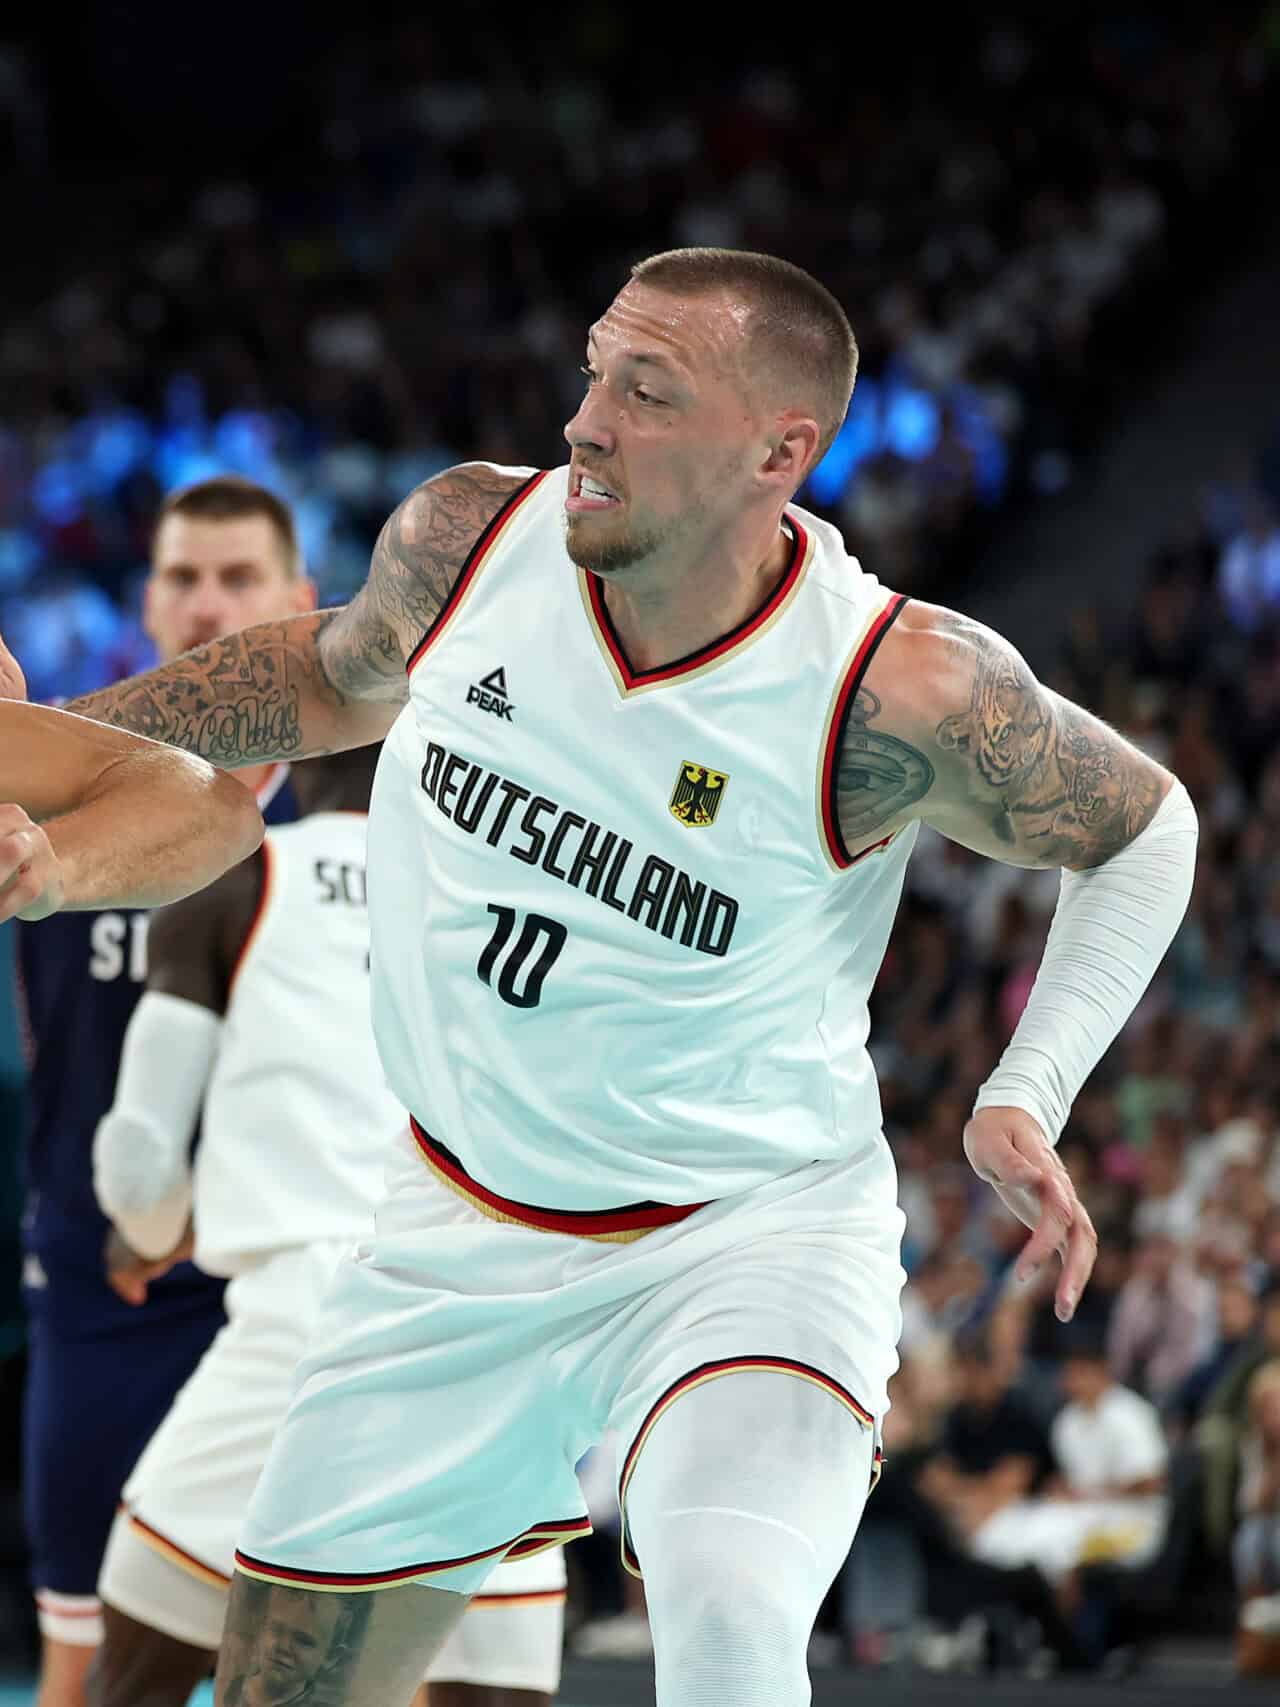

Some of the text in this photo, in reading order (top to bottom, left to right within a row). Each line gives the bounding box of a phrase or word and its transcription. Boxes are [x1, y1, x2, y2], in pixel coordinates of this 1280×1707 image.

[465, 684, 515, 722] PEAK
[420, 741, 739, 958] DEUTSCHLAND
[476, 902, 569, 1009] 10
